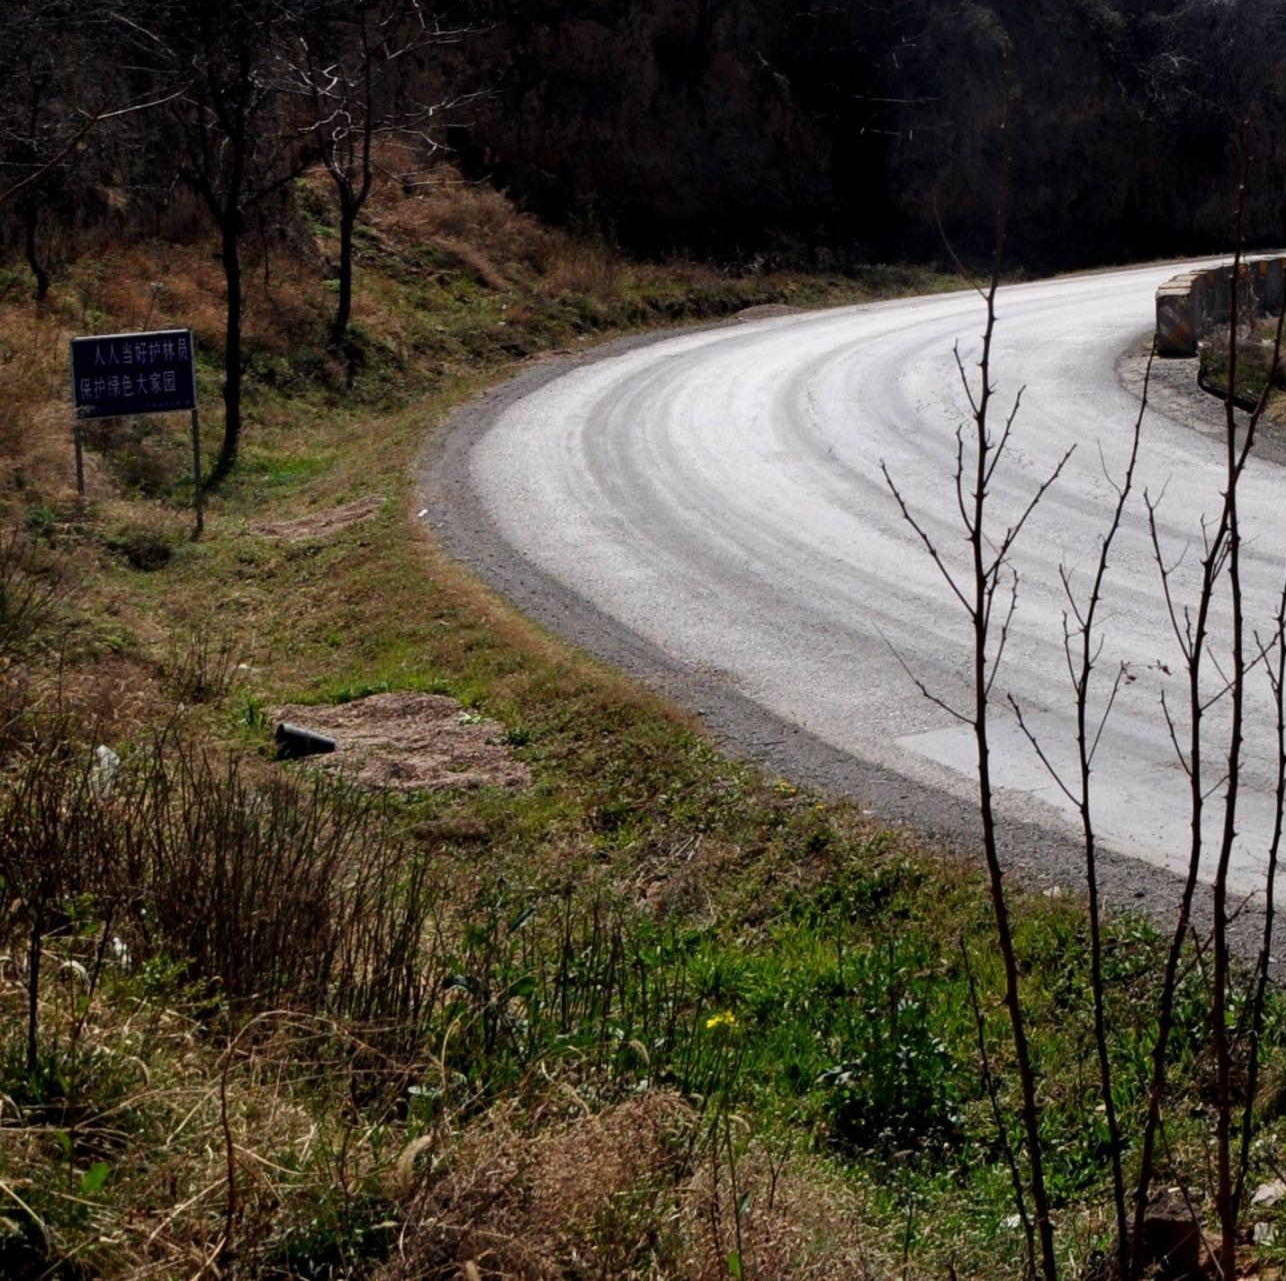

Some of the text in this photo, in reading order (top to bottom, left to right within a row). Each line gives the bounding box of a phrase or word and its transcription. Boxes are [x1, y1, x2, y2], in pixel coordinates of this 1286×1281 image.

[94, 338, 189, 366] 人人当好护林员
[79, 370, 177, 401] 保护绿色大家园
